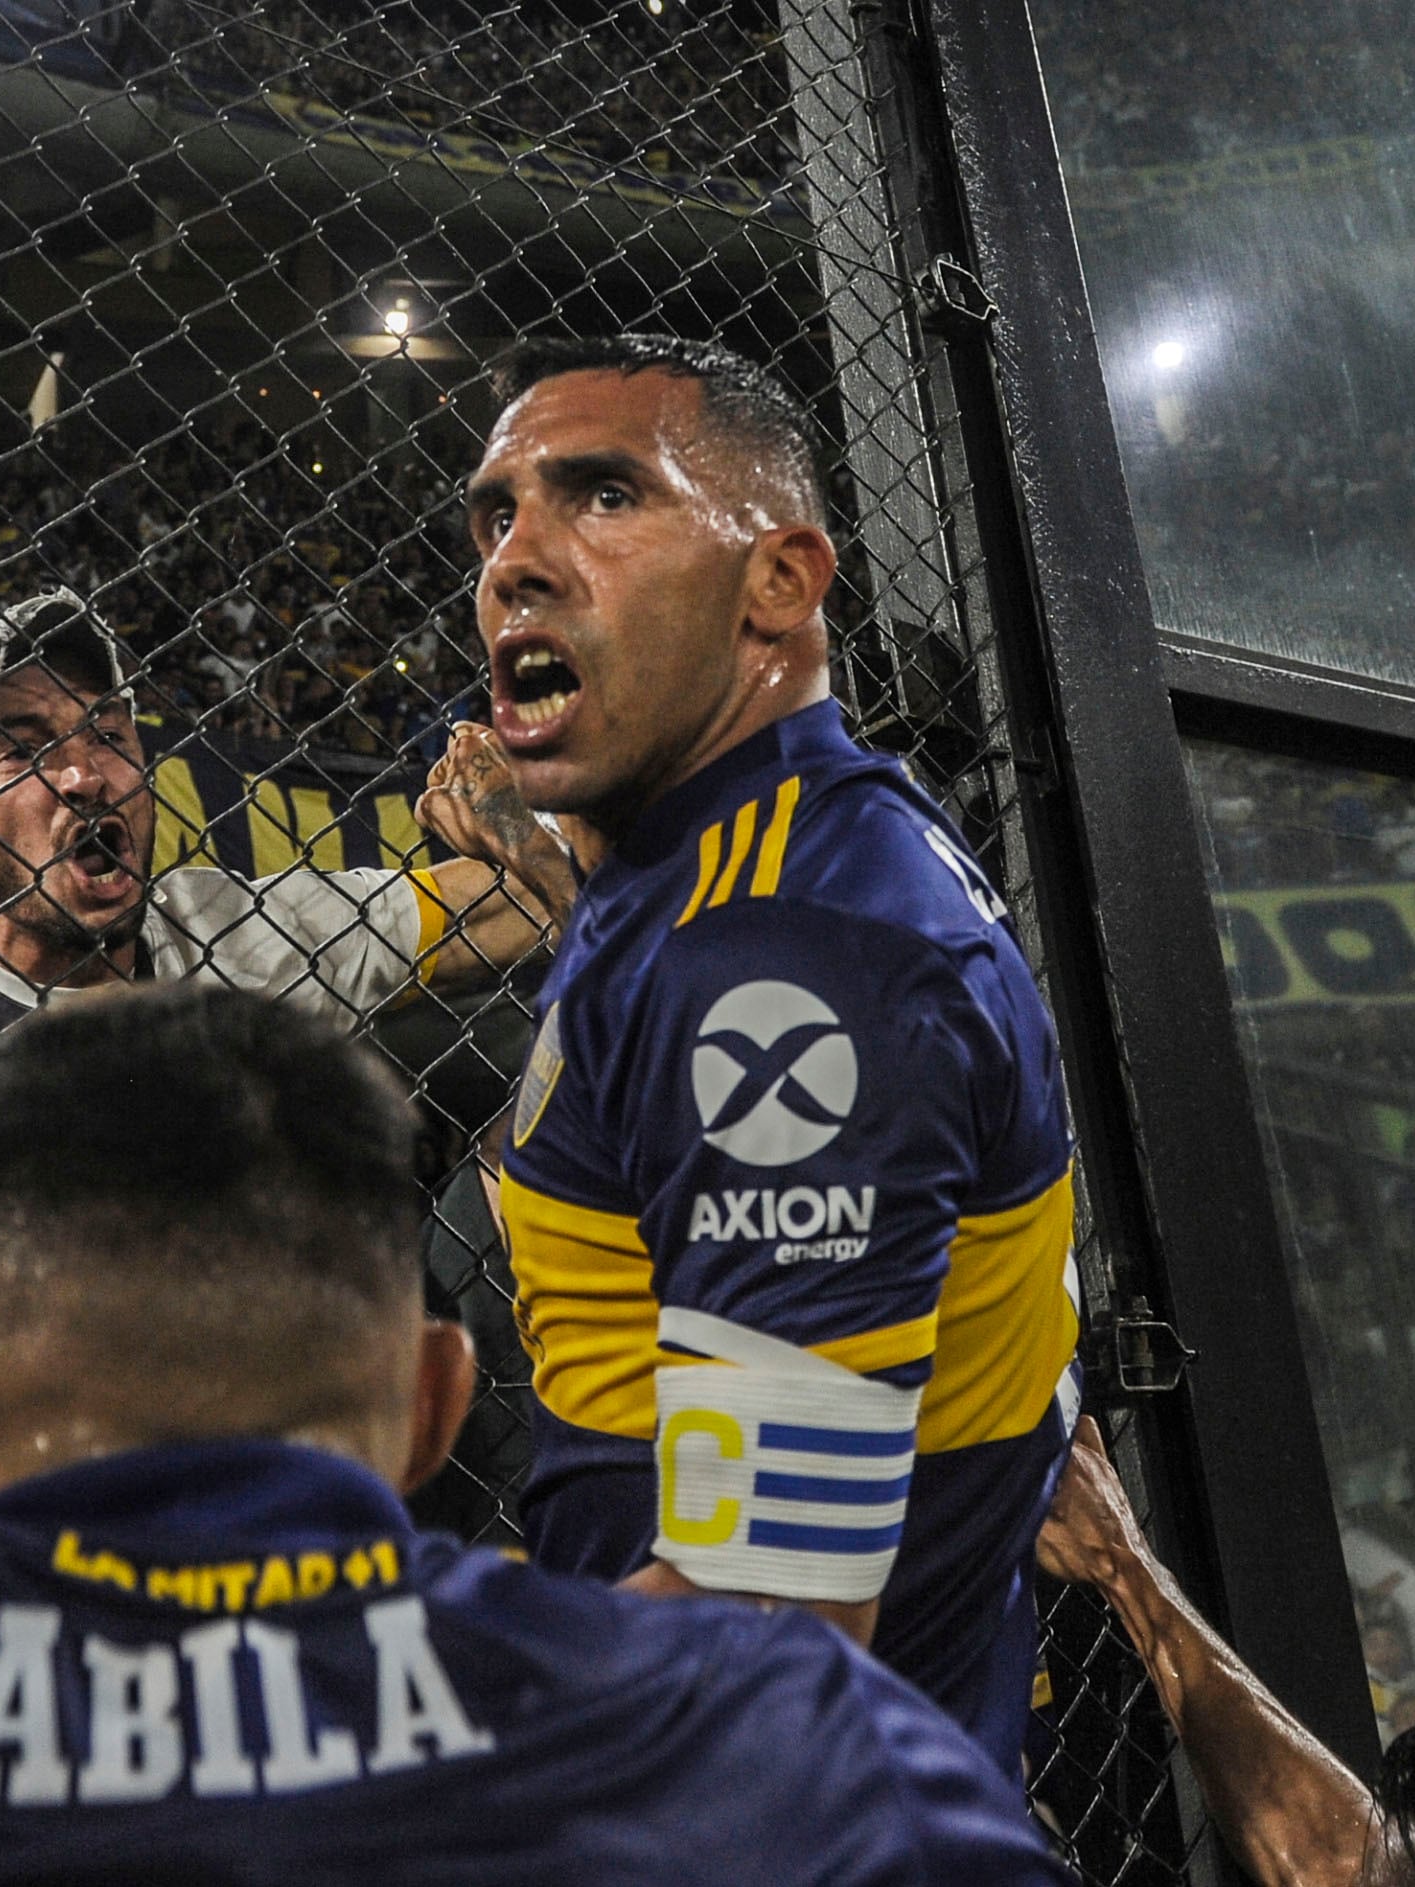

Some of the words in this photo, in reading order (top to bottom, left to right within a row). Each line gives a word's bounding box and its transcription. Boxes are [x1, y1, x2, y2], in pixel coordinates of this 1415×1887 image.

[688, 1185, 876, 1243] AXION
[774, 1236, 870, 1266] energy
[658, 1409, 744, 1545] C
[146, 1549, 338, 1613] MITAD
